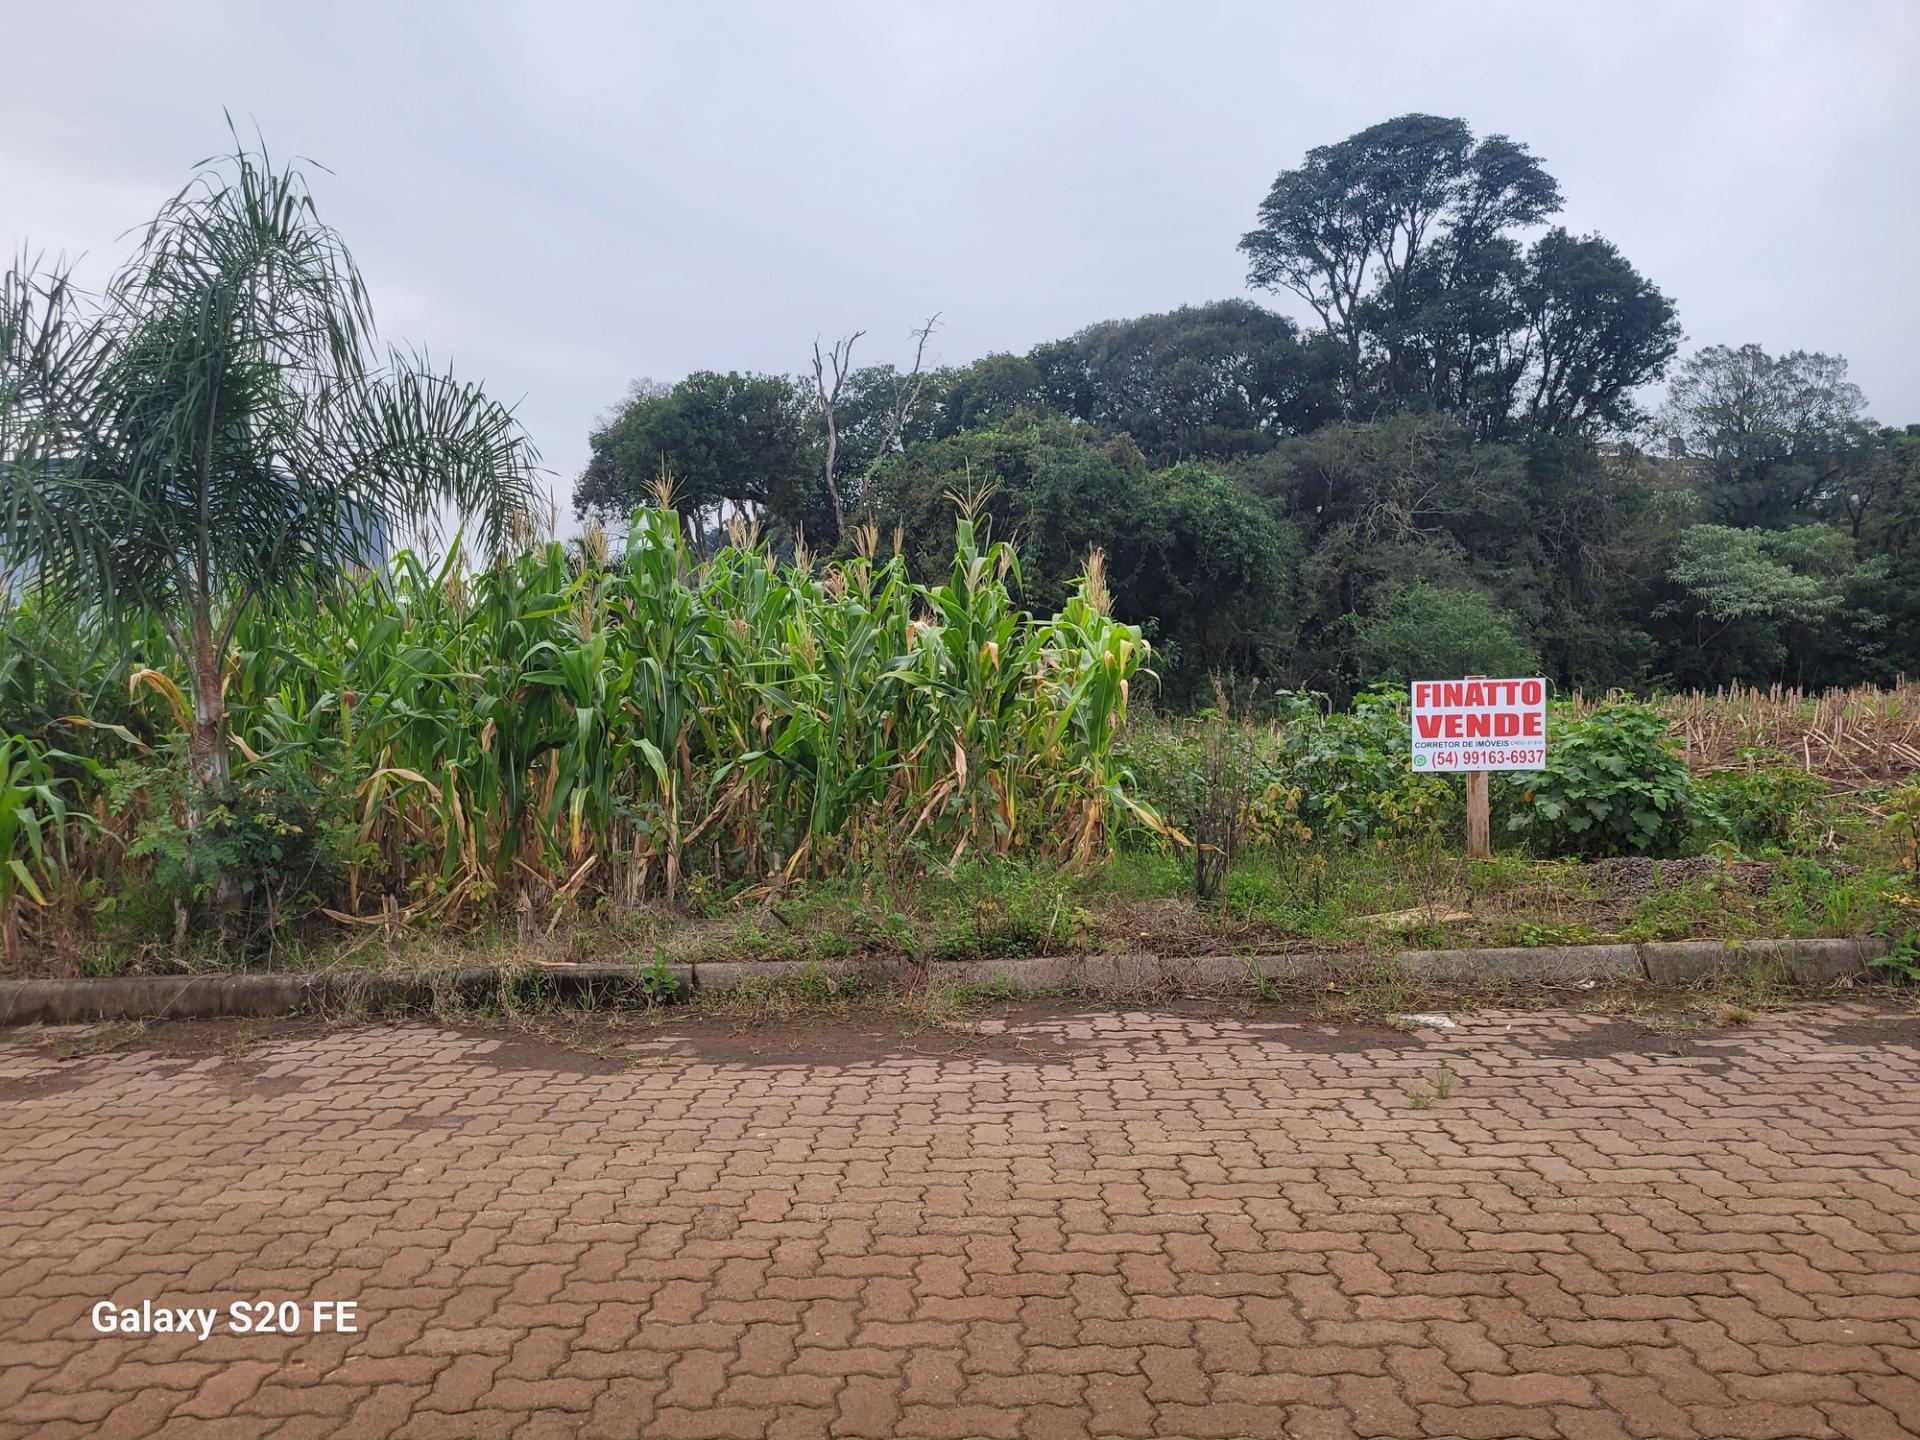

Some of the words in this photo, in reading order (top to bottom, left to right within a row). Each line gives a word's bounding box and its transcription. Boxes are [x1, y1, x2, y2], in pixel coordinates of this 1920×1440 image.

[1416, 681, 1541, 708] FINATTO
[1416, 712, 1542, 738] VENDE
[1414, 741, 1460, 749] CORRETOR
[1462, 740, 1473, 748] DE
[1475, 739, 1509, 748] IMÓVEIS
[1432, 750, 1458, 769] (54)
[1463, 749, 1544, 765] 99163-6937
